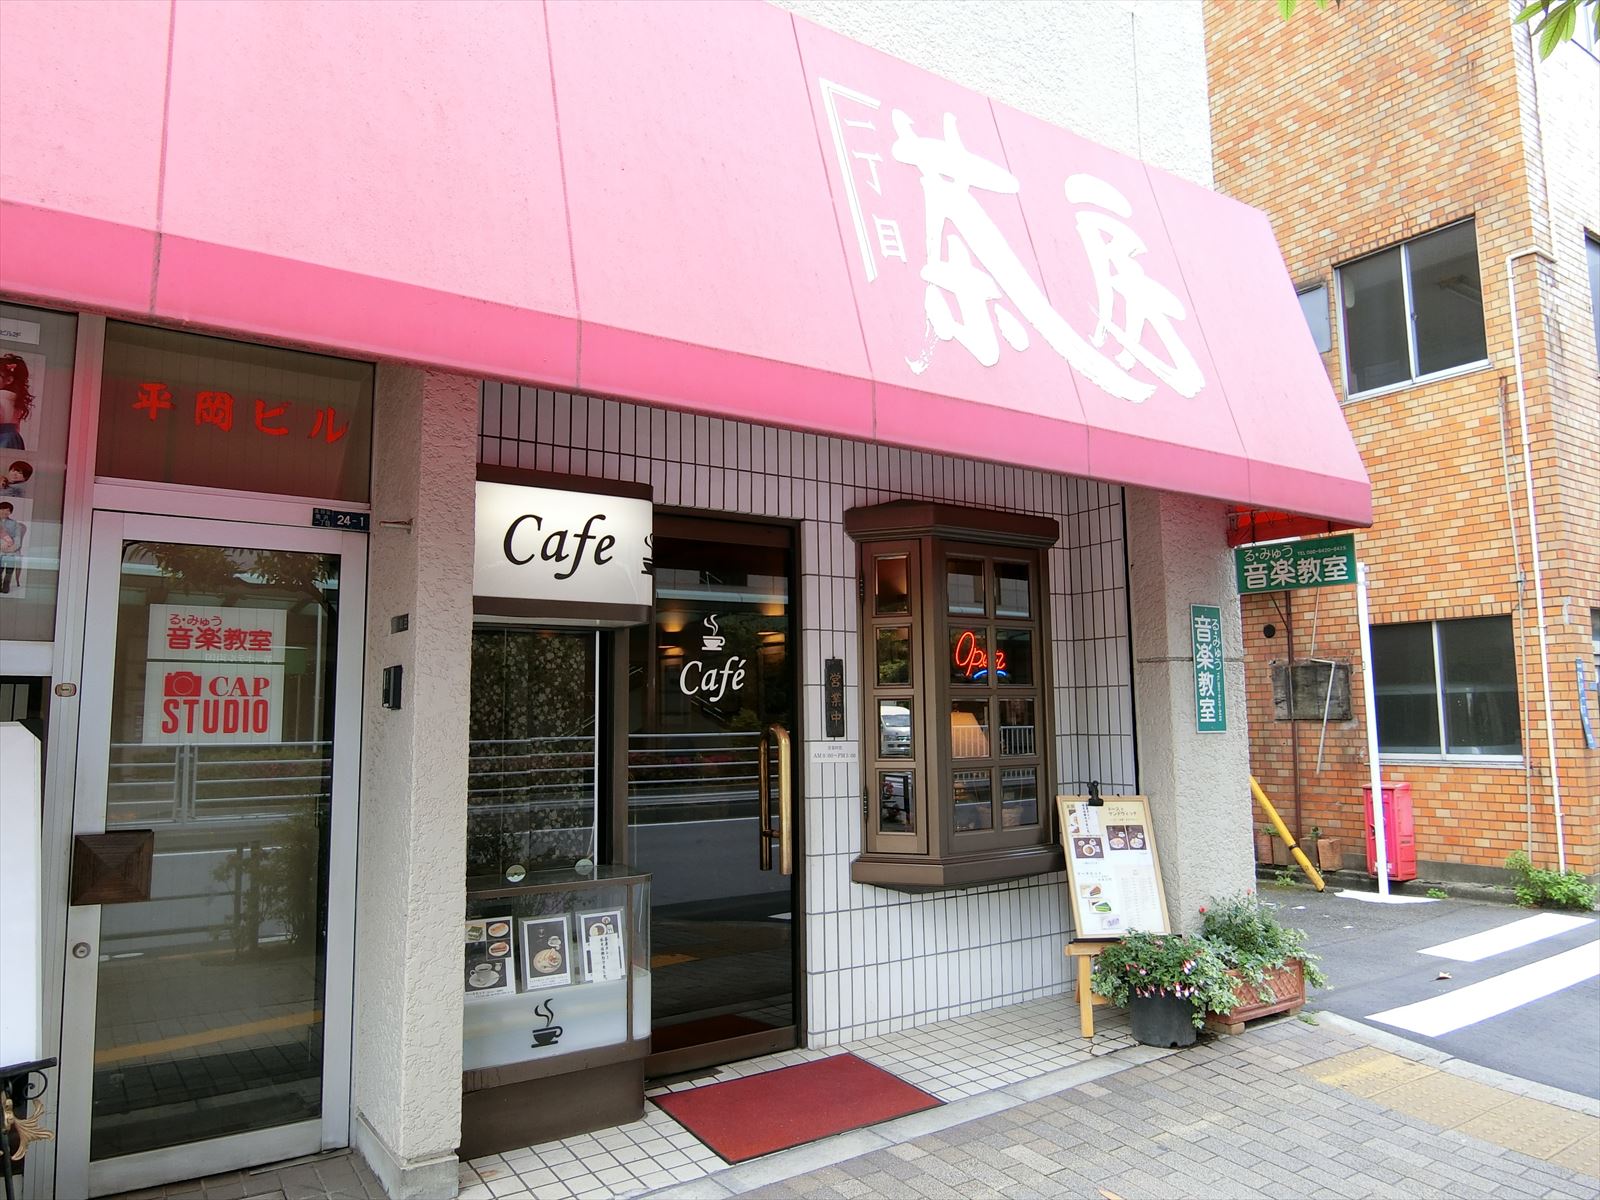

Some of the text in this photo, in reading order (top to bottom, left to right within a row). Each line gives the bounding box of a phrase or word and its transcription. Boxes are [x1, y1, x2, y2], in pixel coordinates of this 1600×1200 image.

[844, 117, 908, 264] 一丁目
[891, 108, 1206, 403] 茶房
[132, 382, 349, 443] 平岡ビル
[503, 514, 615, 580] Cafe
[1244, 554, 1349, 589] 音楽教室
[167, 626, 272, 651] 音楽教室
[208, 676, 270, 697] CAP
[680, 656, 746, 703] Café
[1194, 615, 1217, 723] 音楽教室
[161, 698, 269, 734] STUDIO
[829, 672, 842, 728] 営業中
